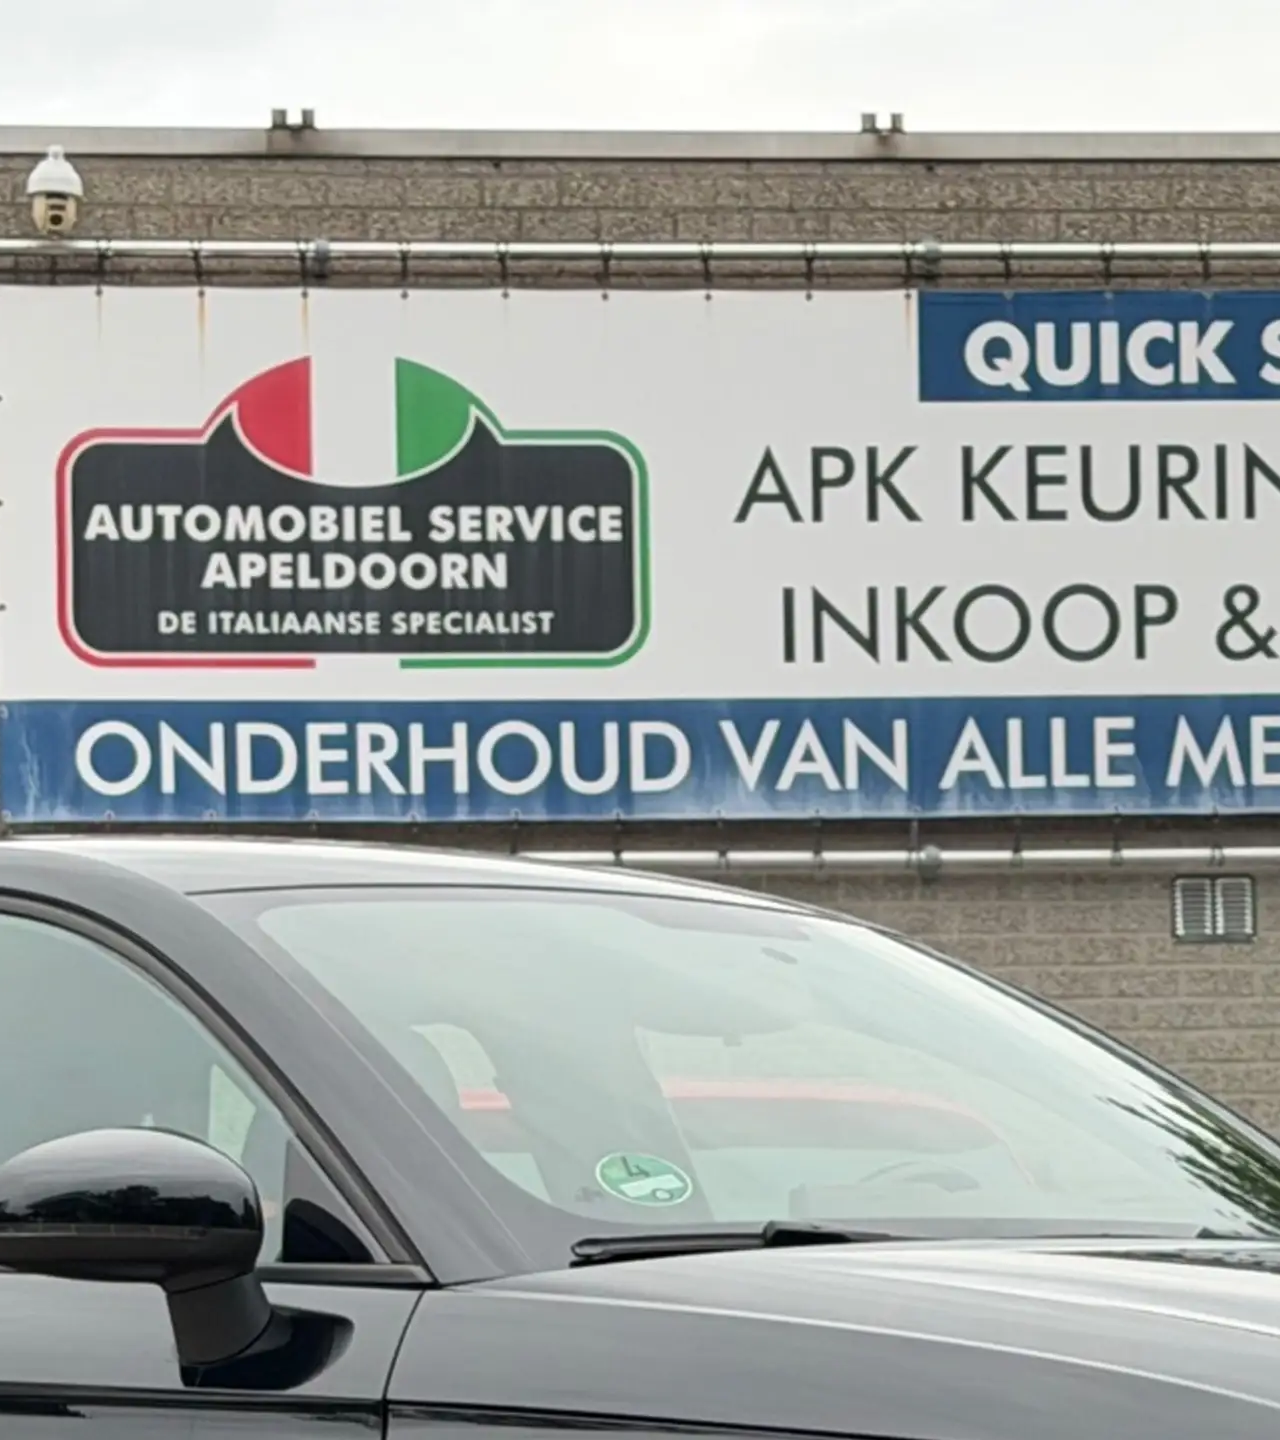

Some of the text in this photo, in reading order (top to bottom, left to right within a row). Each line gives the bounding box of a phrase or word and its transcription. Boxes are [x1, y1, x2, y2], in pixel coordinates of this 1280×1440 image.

[963, 320, 1237, 392] QUICK
[734, 444, 922, 524] APK
[83, 504, 624, 543] AUTOMOBIEL SERVICE
[201, 552, 508, 590] APELDOORN
[157, 610, 555, 636] DE ITALIAANSE SPECIALIST
[781, 582, 1179, 664] INKOOP
[1214, 583, 1280, 661] &
[74, 719, 693, 798] ONDERHOUD
[718, 717, 909, 795] VAN
[939, 716, 1137, 791] ALLE
